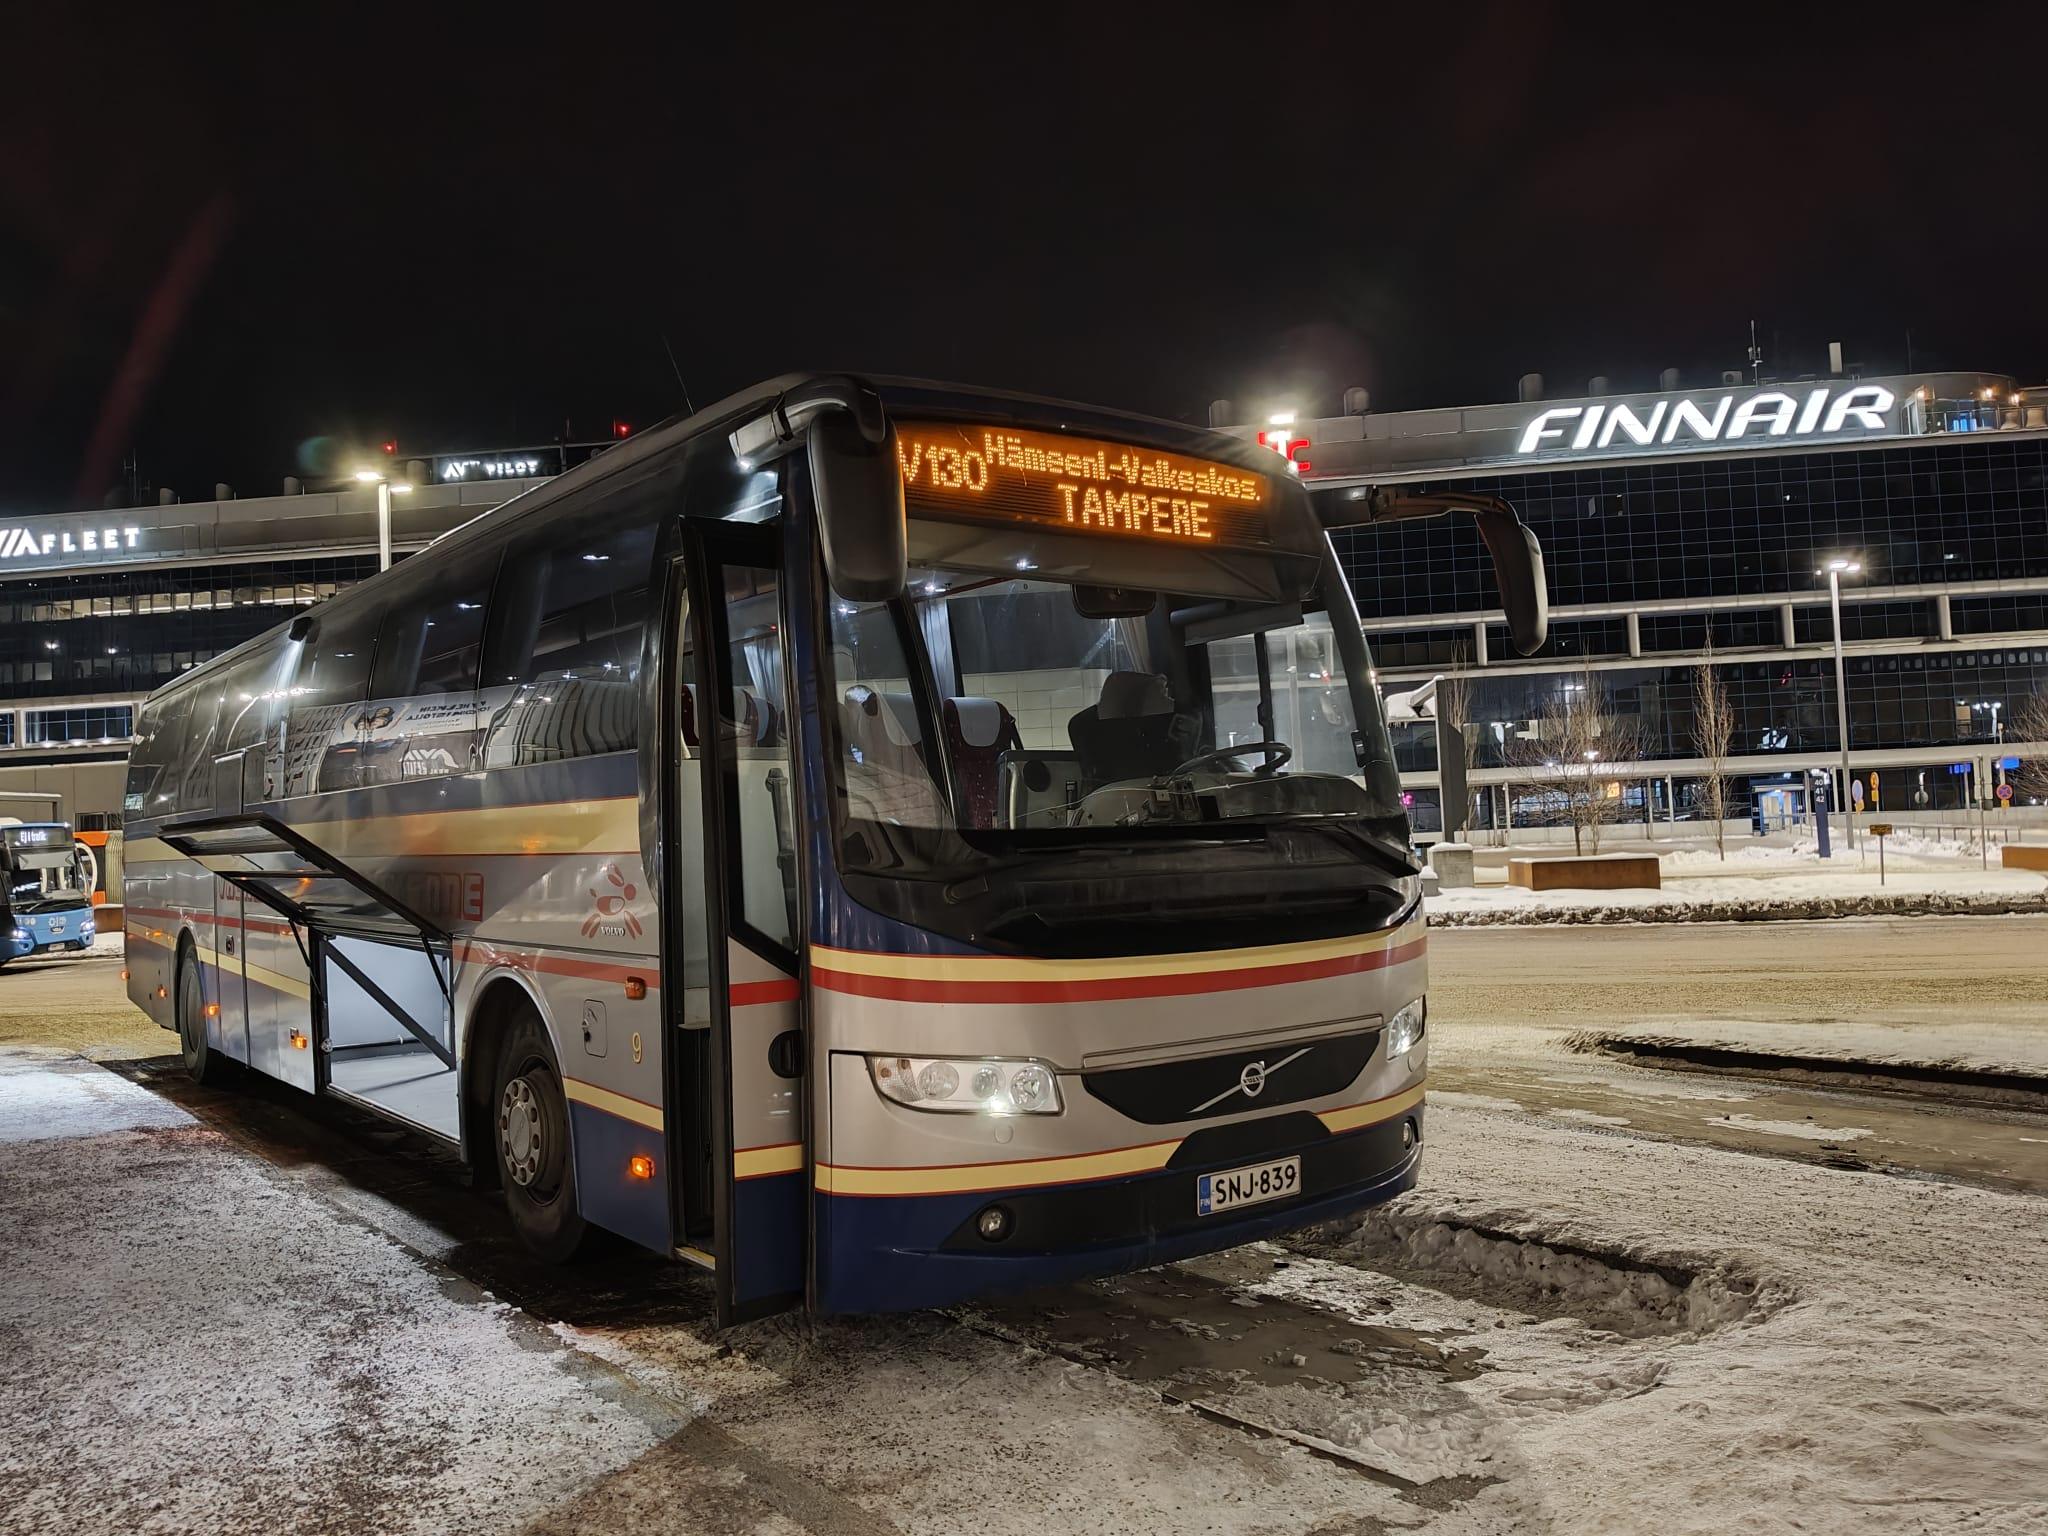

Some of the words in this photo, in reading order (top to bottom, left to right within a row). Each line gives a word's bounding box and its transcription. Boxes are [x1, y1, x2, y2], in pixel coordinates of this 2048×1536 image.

[1517, 385, 1896, 454] FINNAIR
[486, 460, 538, 475] PILOT
[898, 439, 989, 492] V130
[1057, 482, 1212, 539] TAMPERE
[41, 527, 140, 554] FLEET
[1814, 778, 1824, 786] 40
[1815, 795, 1825, 803] 42
[600, 926, 626, 937] VOLVO
[632, 1032, 643, 1064] 9
[1215, 1163, 1297, 1205] SNJ-839
[1200, 1199, 1211, 1207] FIN
